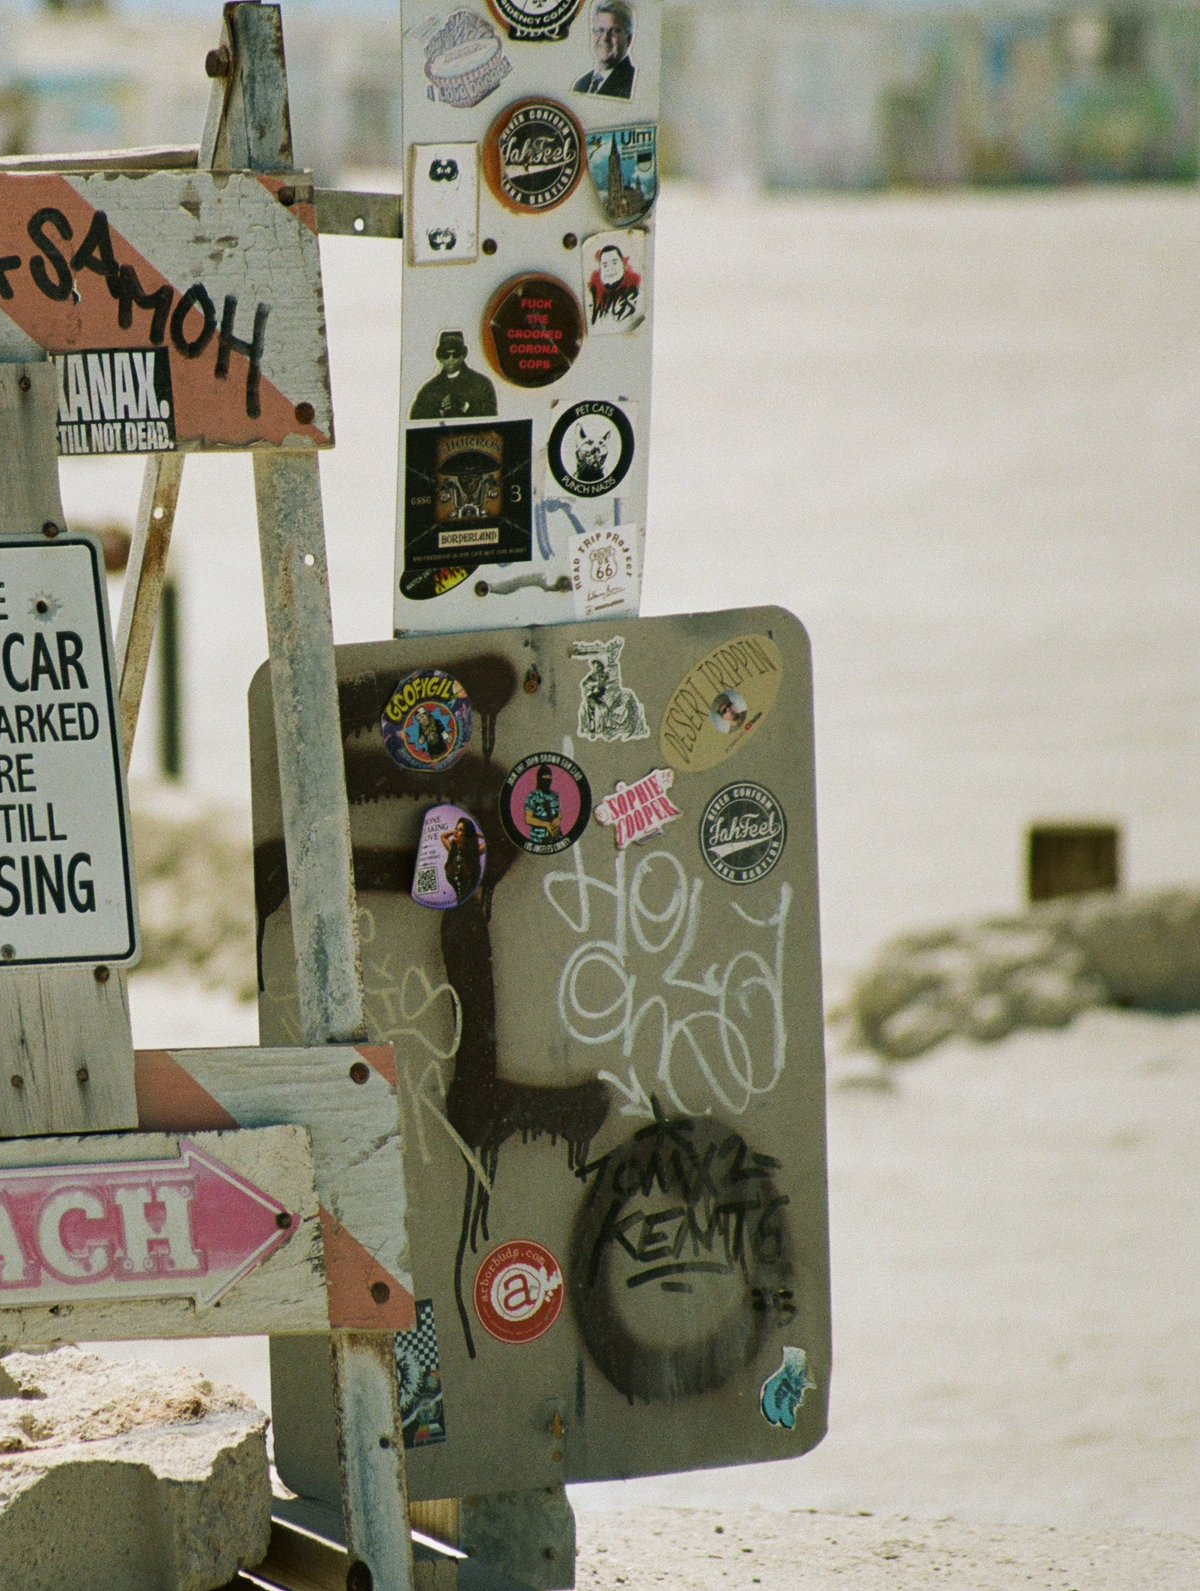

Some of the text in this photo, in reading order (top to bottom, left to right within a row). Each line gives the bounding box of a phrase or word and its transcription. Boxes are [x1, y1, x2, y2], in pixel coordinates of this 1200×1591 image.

[529, 109, 570, 136] CONFORM
[621, 130, 652, 146] Ulm
[529, 168, 573, 204] BABYLON
[521, 299, 553, 309] FUCK
[526, 314, 549, 324] THE
[507, 329, 563, 339] CROOKED
[510, 345, 558, 354] CORONA
[519, 359, 551, 370] COPS
[575, 403, 615, 417] PET CATS
[58, 421, 175, 454] TILL NOT DEAD.
[510, 484, 522, 503] 3
[561, 475, 616, 494] PUNCH NAZIS
[441, 530, 497, 545] BORDERLAND
[573, 532, 632, 590] ROAD TRIP PROJECT
[596, 564, 613, 579] 66
[2, 631, 89, 692] CAR
[664, 677, 710, 763] DESERT
[697, 639, 777, 693] TRIPPIN
[606, 774, 663, 820] SOPHIE
[708, 788, 772, 821] NEVER CONFORM
[617, 796, 680, 848] COOPER
[709, 811, 780, 845] JahFeel
[712, 841, 779, 880] INNA BABYLON
[481, 1248, 545, 1303] arborbuds.com
